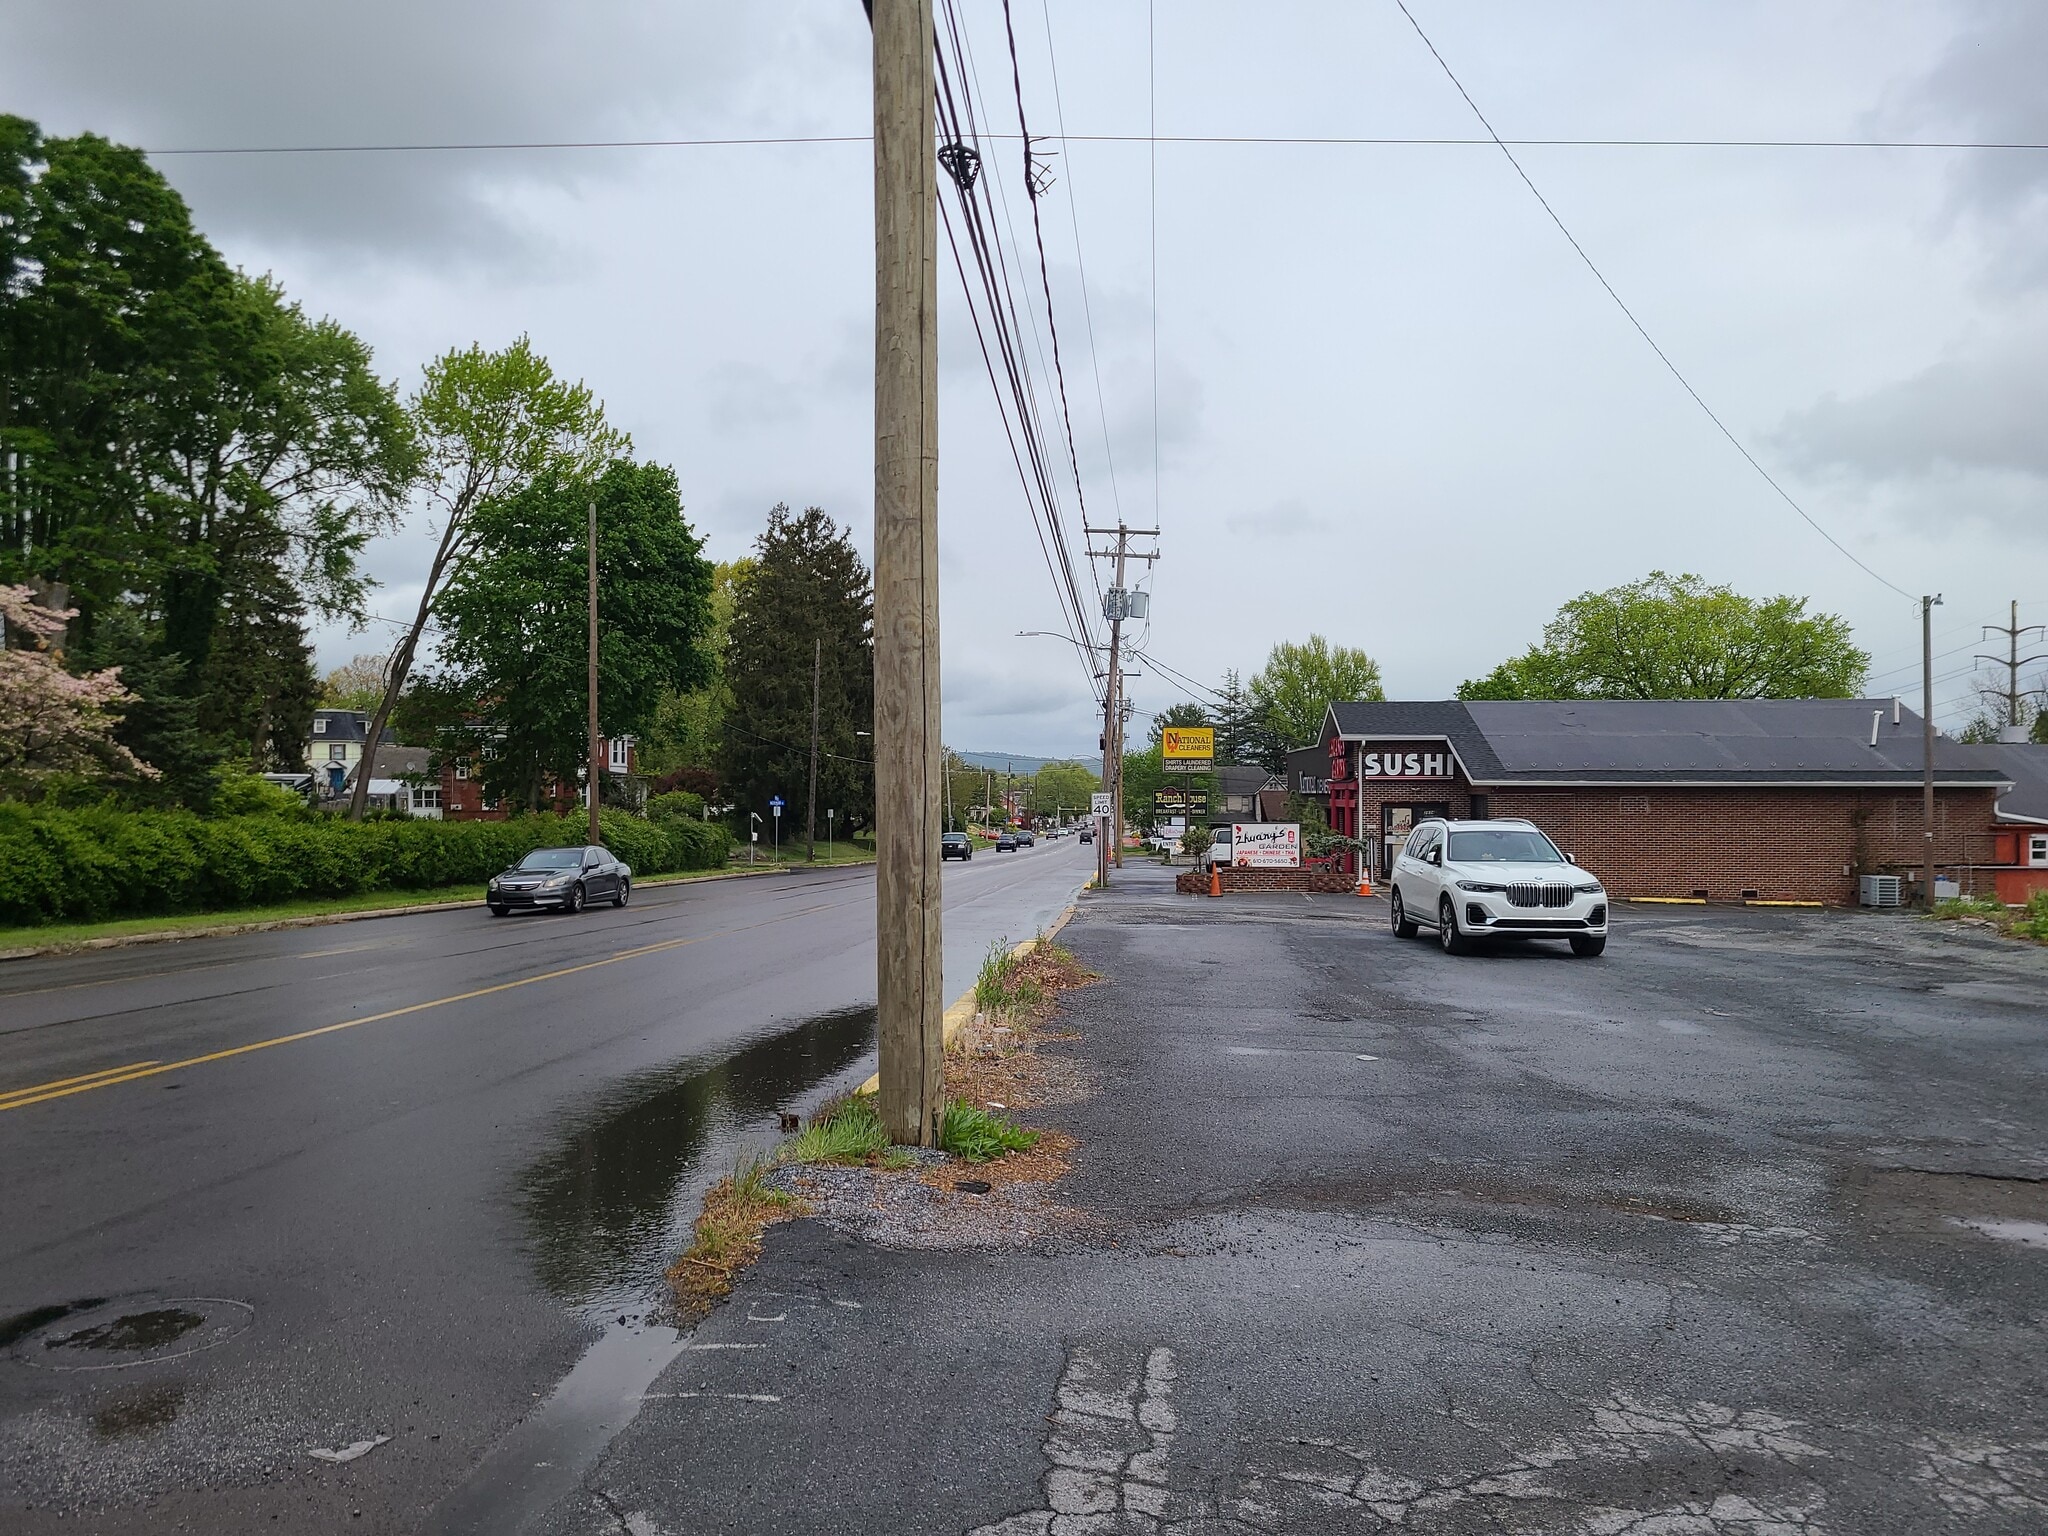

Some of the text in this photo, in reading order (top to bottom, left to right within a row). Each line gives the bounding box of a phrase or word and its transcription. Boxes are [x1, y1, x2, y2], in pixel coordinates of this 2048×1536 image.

[1168, 733, 1211, 744] NATIONAL
[1365, 753, 1454, 776] SUSHI
[1155, 792, 1182, 804] Ranch
[1093, 805, 1110, 814] 40
